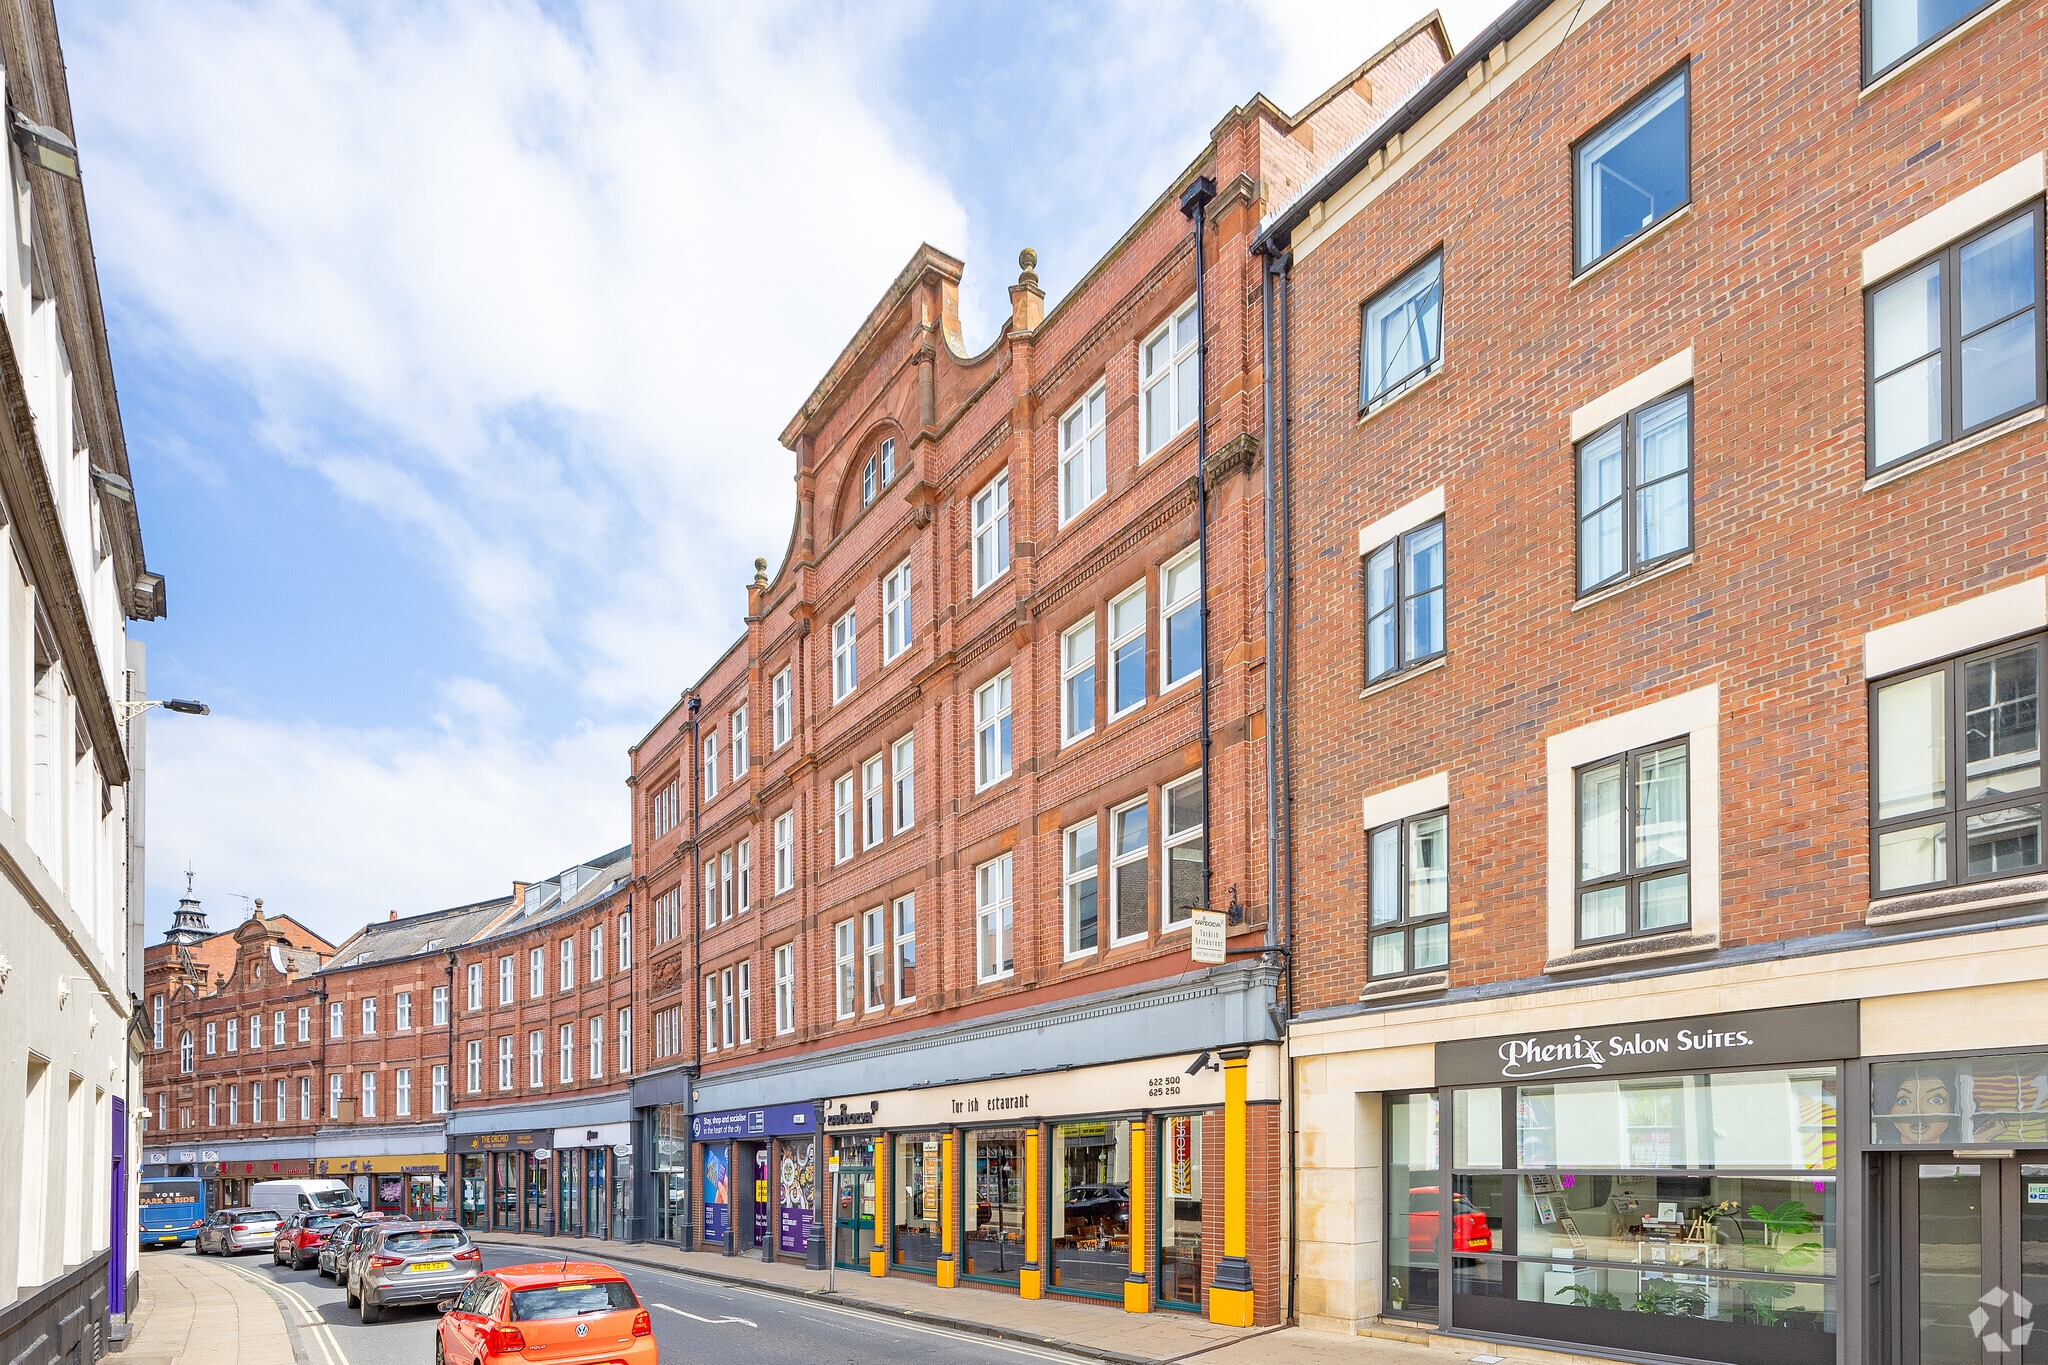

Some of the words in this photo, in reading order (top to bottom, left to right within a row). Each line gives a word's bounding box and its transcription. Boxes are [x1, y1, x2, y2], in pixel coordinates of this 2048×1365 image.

[1499, 1034, 1606, 1077] Phenix
[1149, 1077, 1163, 1086] 622
[1165, 1076, 1180, 1085] 500
[1149, 1087, 1163, 1096] 625
[1165, 1086, 1180, 1095] 250
[987, 1094, 1029, 1111] estaurant
[713, 1116, 721, 1125] shop
[714, 1126, 723, 1134] heart
[734, 1124, 742, 1134] city
[481, 1135, 491, 1144] THE
[140, 1197, 164, 1205] PARK
